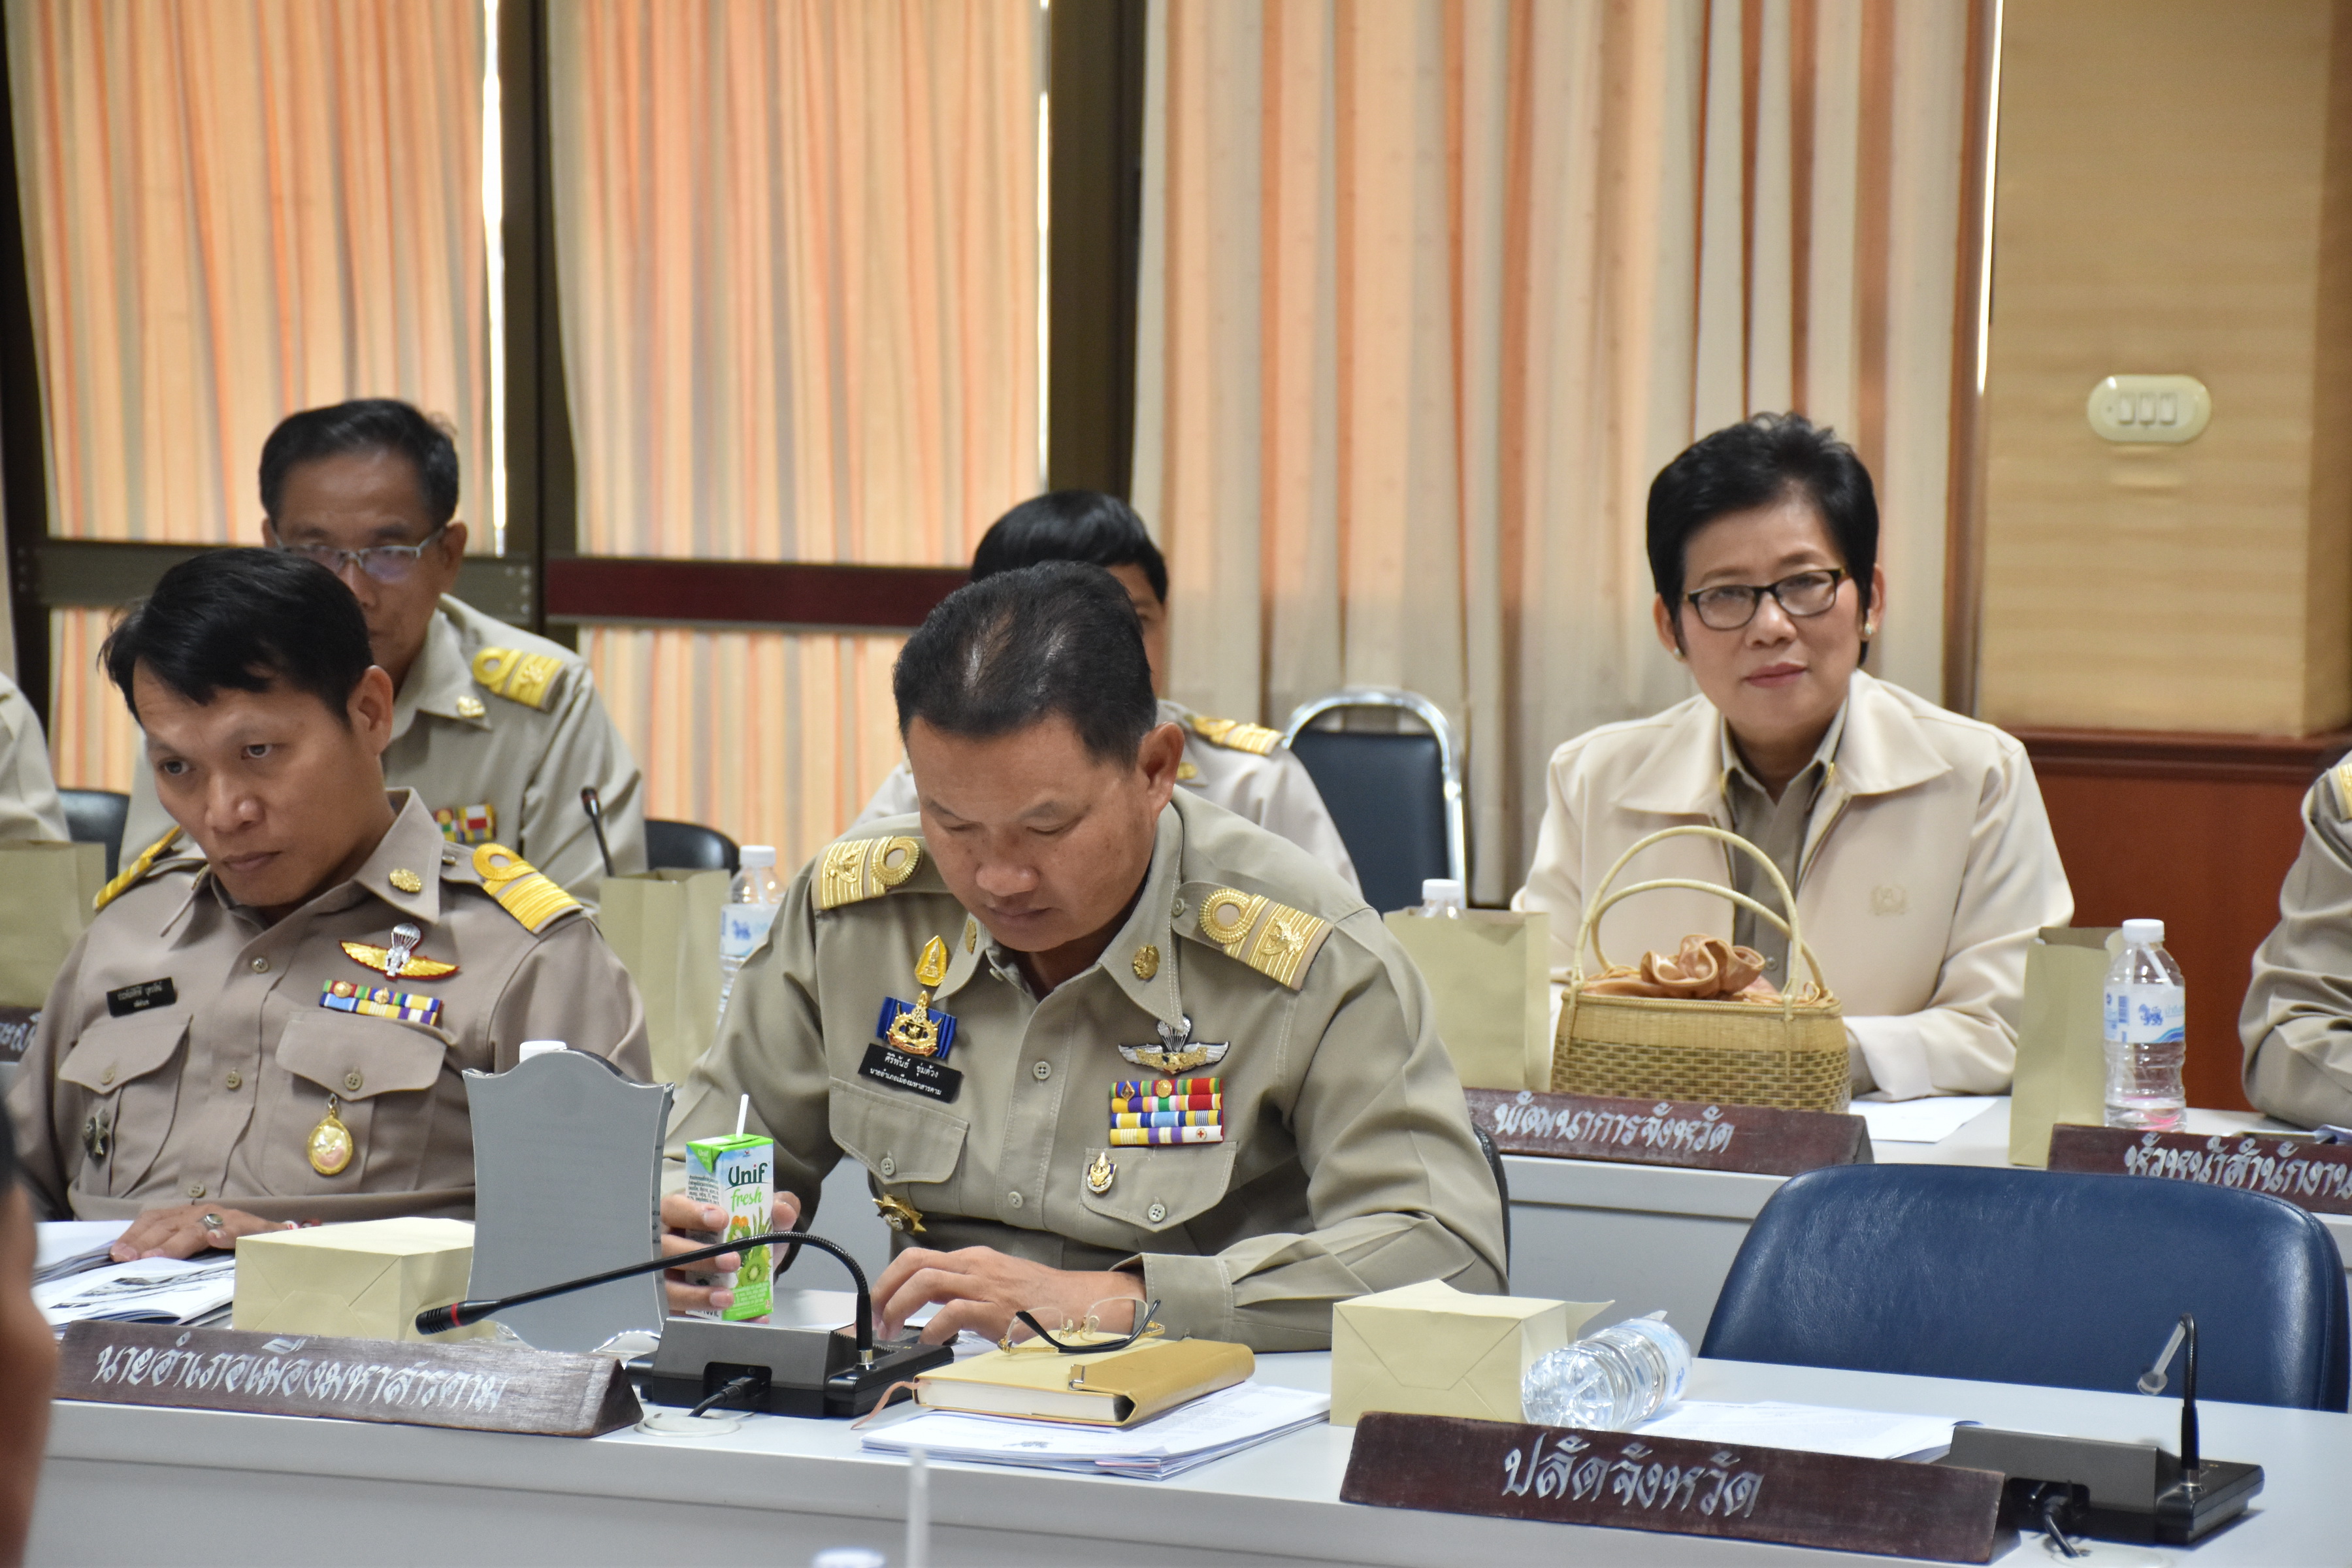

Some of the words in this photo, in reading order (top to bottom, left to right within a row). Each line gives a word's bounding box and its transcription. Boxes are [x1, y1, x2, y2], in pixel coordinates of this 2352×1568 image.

[870, 1068, 941, 1096] นายอำเภอเมืองมหาสารคาม
[728, 1162, 768, 1186] Unif
[730, 1186, 763, 1211] fresh
[1503, 1433, 1765, 1518] ปลัดจังหวัด
